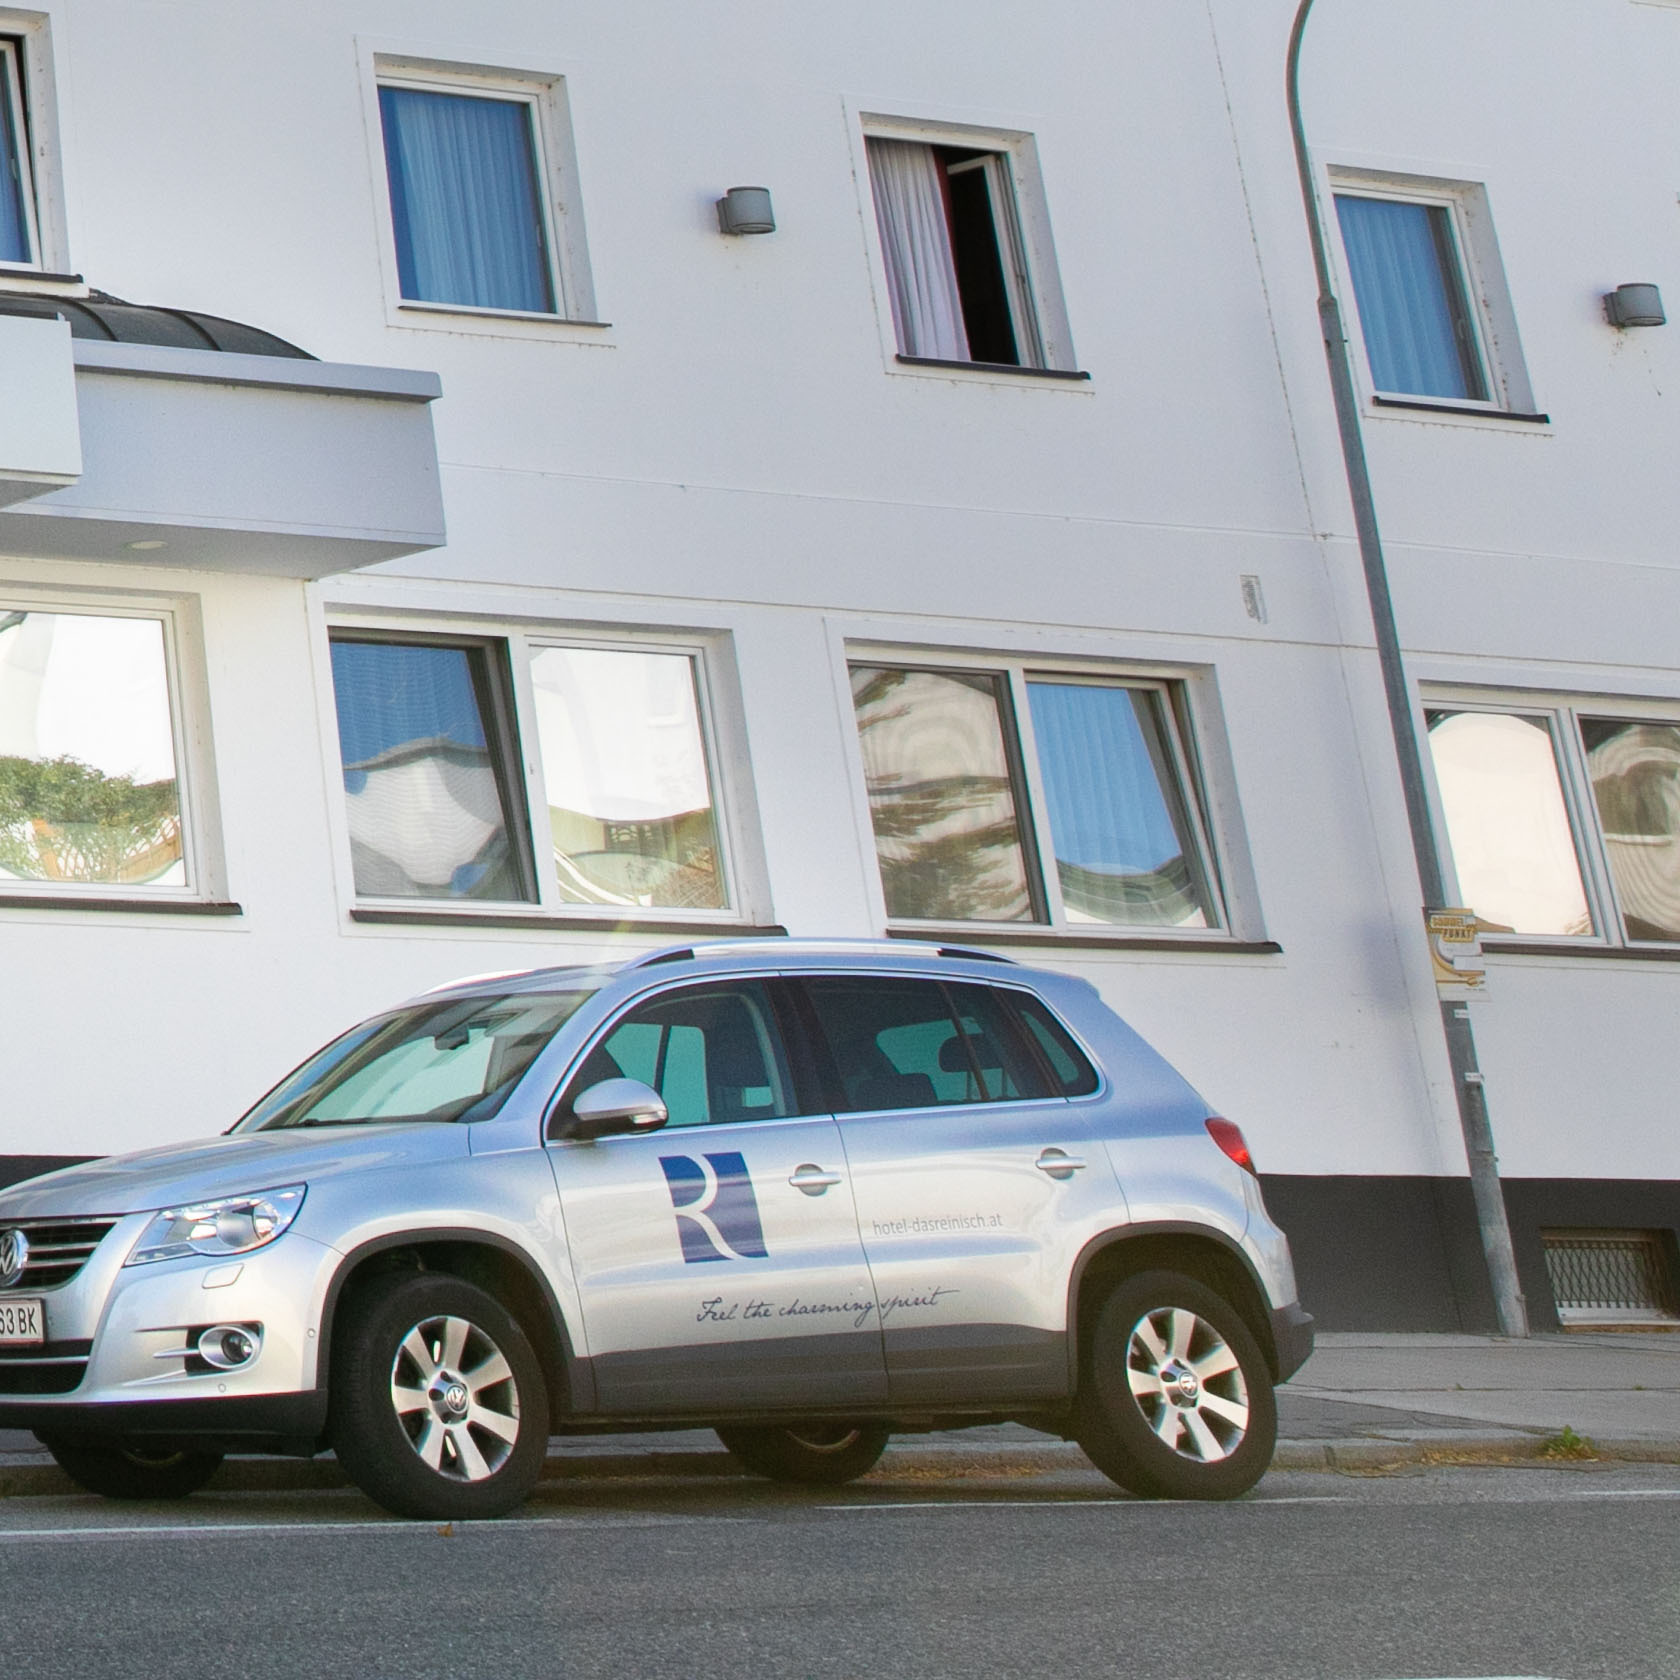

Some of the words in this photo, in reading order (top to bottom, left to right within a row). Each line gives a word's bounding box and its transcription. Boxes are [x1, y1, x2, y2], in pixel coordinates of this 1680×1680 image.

[872, 1212, 1003, 1236] hotel-dasreinisch.at
[18, 1306, 37, 1335] BK
[696, 1296, 737, 1322] Feel
[743, 1299, 776, 1320] the
[778, 1292, 875, 1329] charming
[879, 1286, 961, 1320] spirit
